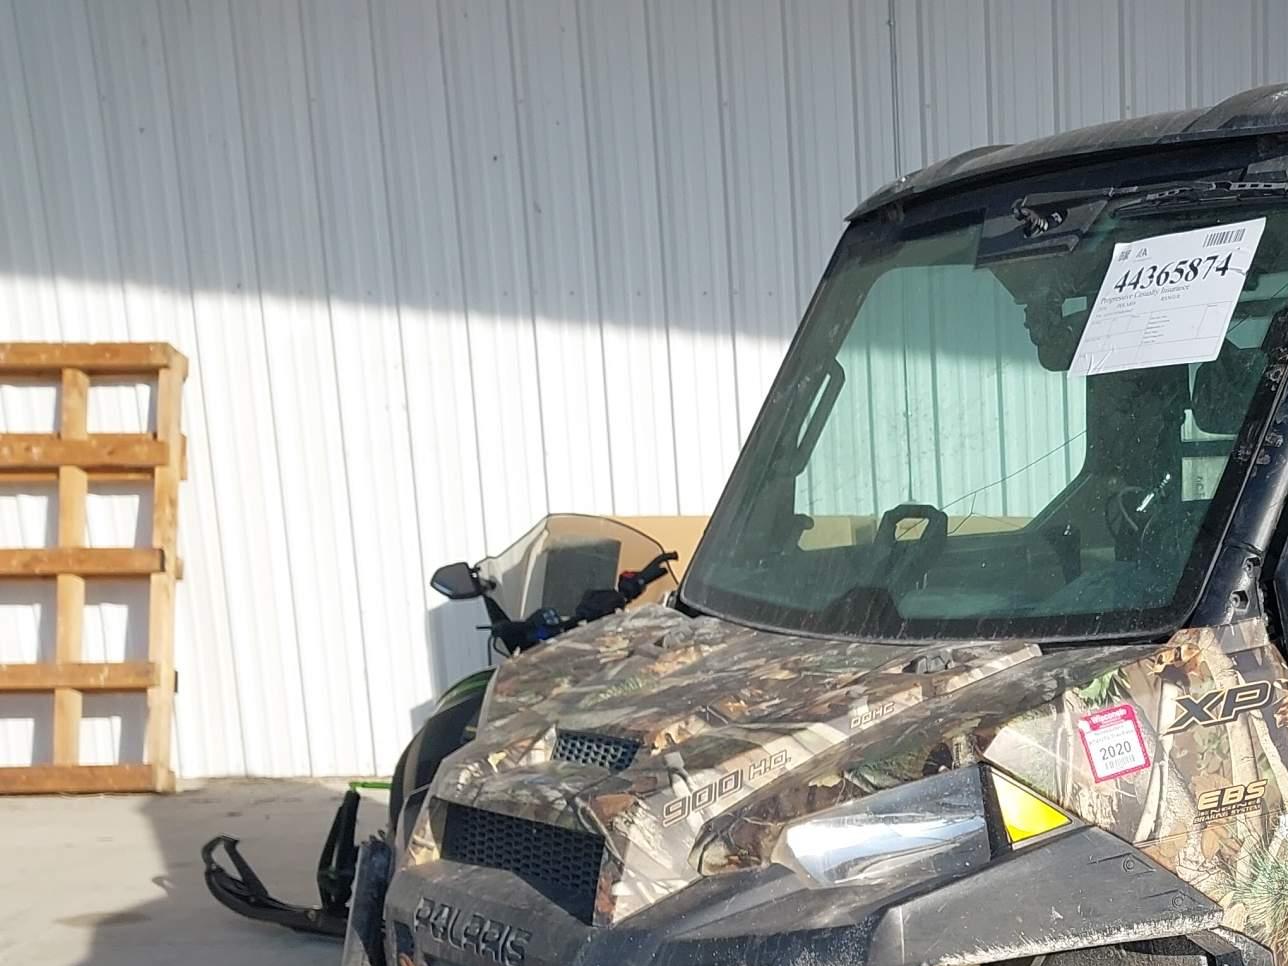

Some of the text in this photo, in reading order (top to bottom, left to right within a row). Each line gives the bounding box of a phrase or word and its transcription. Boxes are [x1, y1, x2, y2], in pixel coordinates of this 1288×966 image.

[1113, 253, 1233, 293] 44365874
[850, 702, 896, 729] DOHC
[1163, 680, 1272, 736] XP
[1099, 740, 1132, 761] 2020
[663, 769, 744, 828] 900
[1197, 779, 1268, 811] EBS
